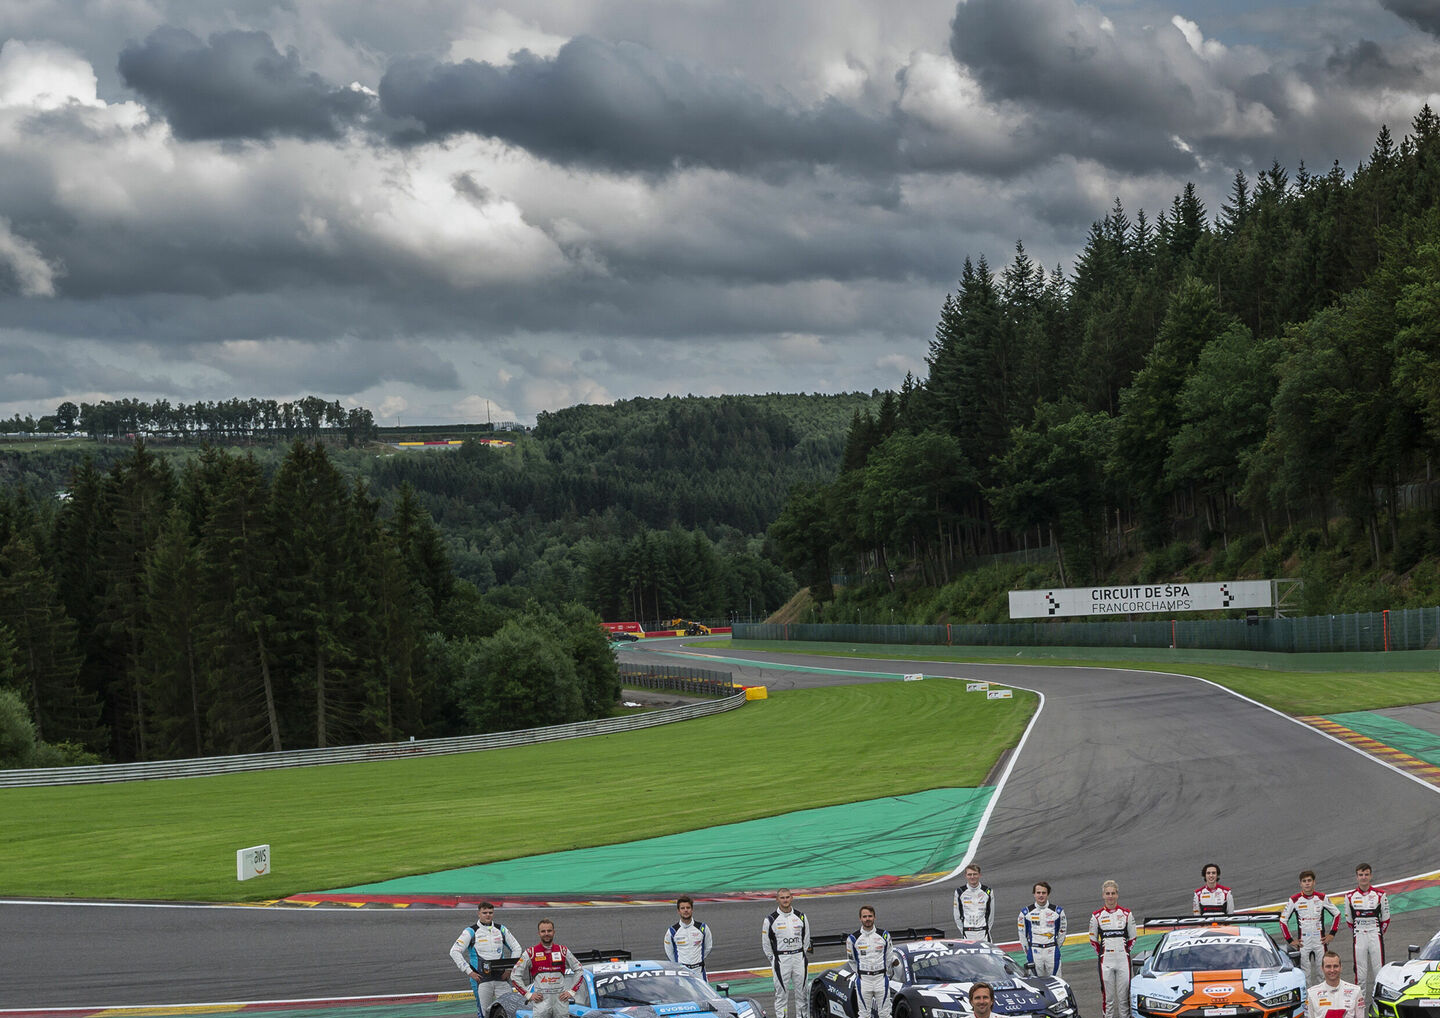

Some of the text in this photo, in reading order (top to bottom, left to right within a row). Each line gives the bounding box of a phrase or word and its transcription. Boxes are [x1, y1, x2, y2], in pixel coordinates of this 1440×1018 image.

[1091, 586, 1189, 601] CIRCUIT DE SPA
[1092, 600, 1191, 613] FRANCORCHAMPS
[914, 949, 1005, 962] FANATEC
[596, 970, 690, 988] FANATEC
